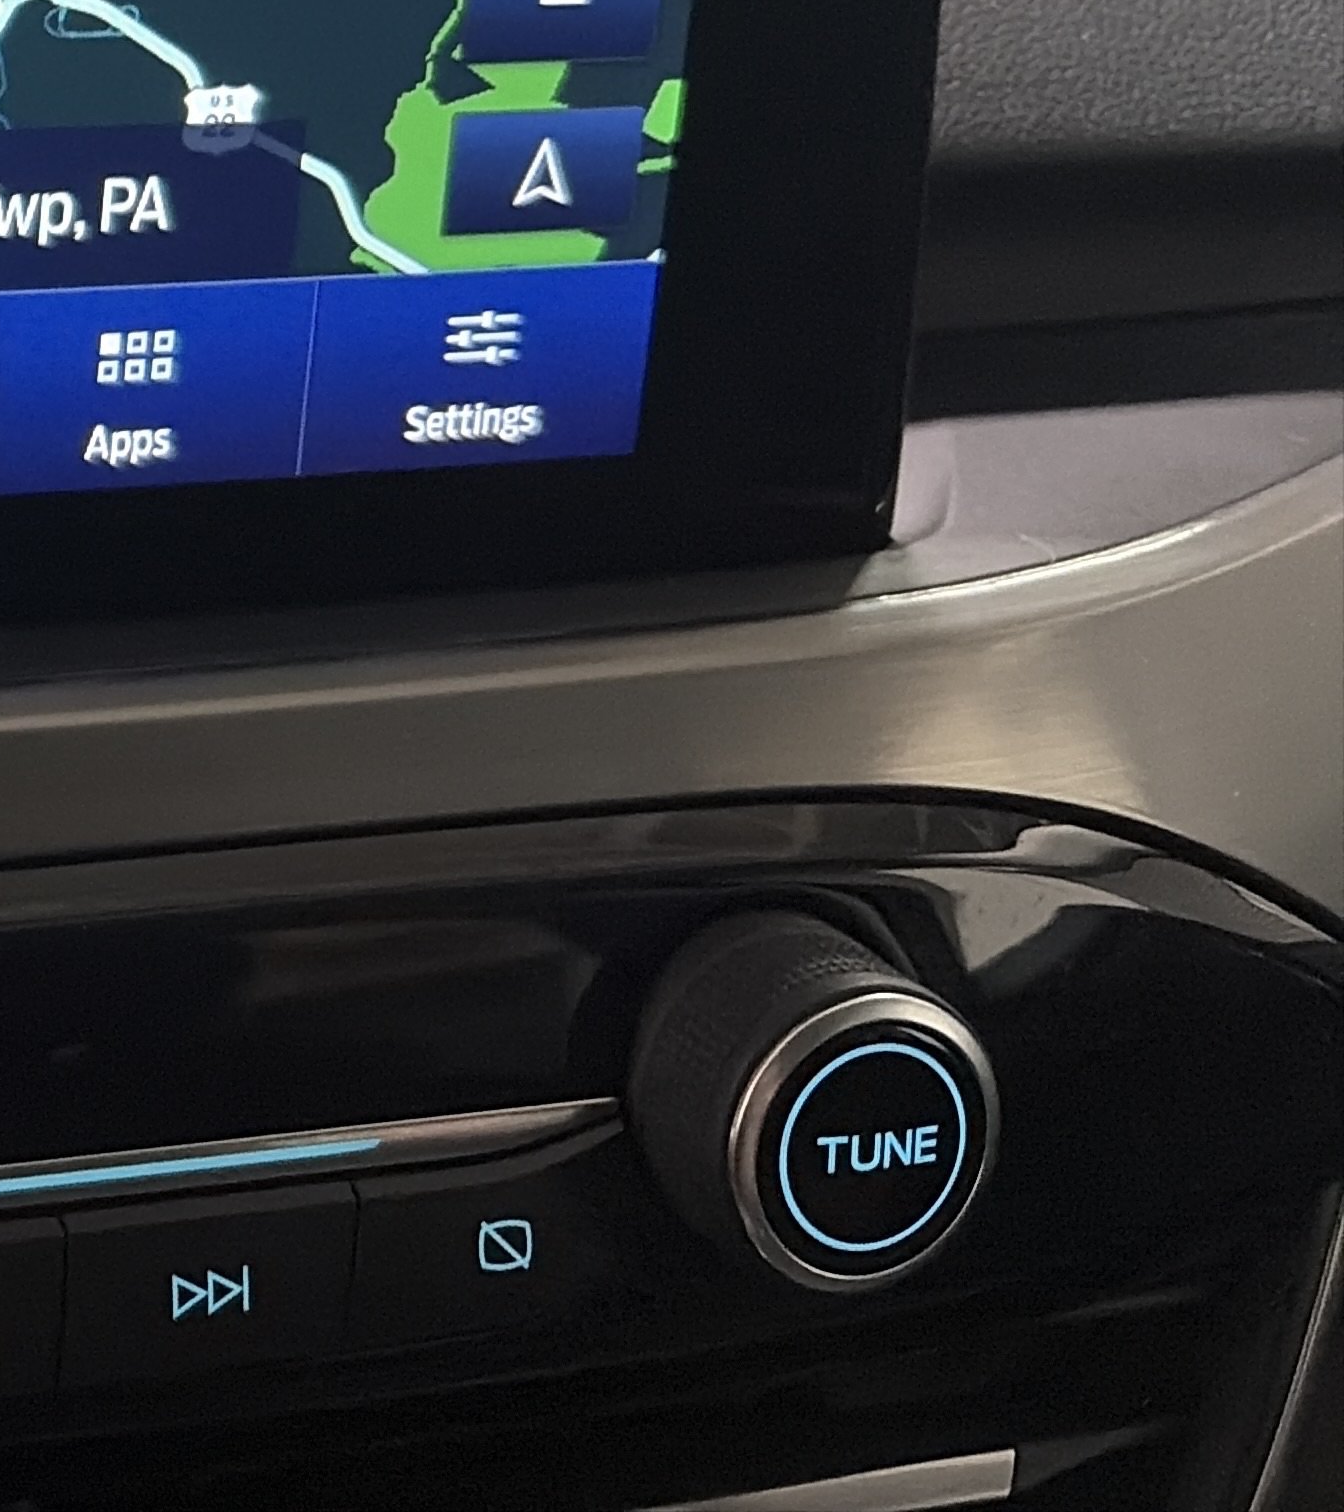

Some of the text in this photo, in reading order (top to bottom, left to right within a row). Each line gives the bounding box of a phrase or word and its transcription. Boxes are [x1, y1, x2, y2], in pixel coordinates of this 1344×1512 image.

[100, 175, 170, 233] PA
[83, 424, 173, 467] Apps
[403, 402, 542, 444] Settings
[816, 1124, 940, 1175] TUNE
